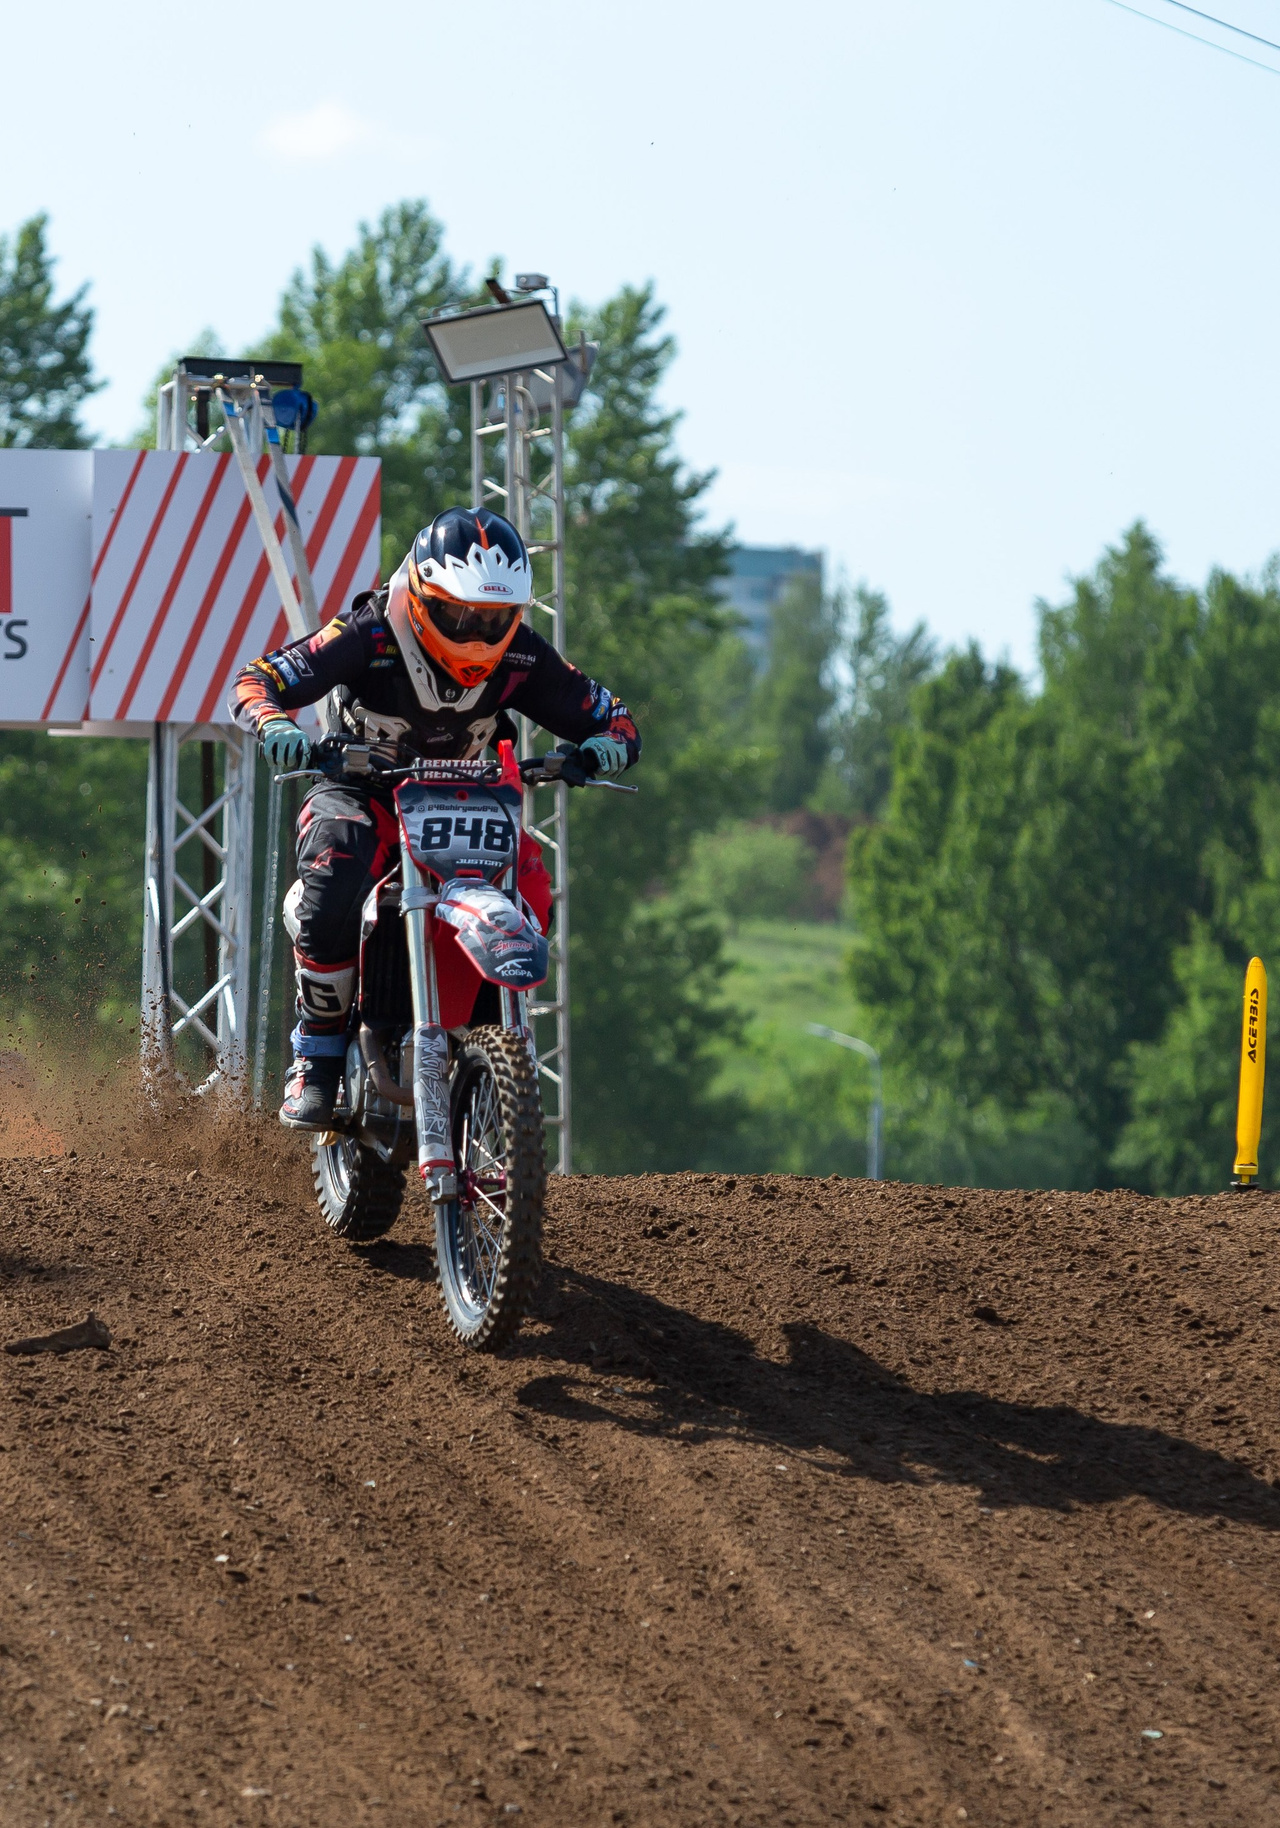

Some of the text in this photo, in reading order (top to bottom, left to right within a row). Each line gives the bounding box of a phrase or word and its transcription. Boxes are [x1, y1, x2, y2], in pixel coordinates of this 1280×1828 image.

[483, 585, 509, 593] BELL
[422, 759, 492, 768] RENTHAL
[420, 817, 512, 853] 848
[501, 969, 533, 978] КОБРА
[1248, 988, 1258, 1063] ACERBIS
